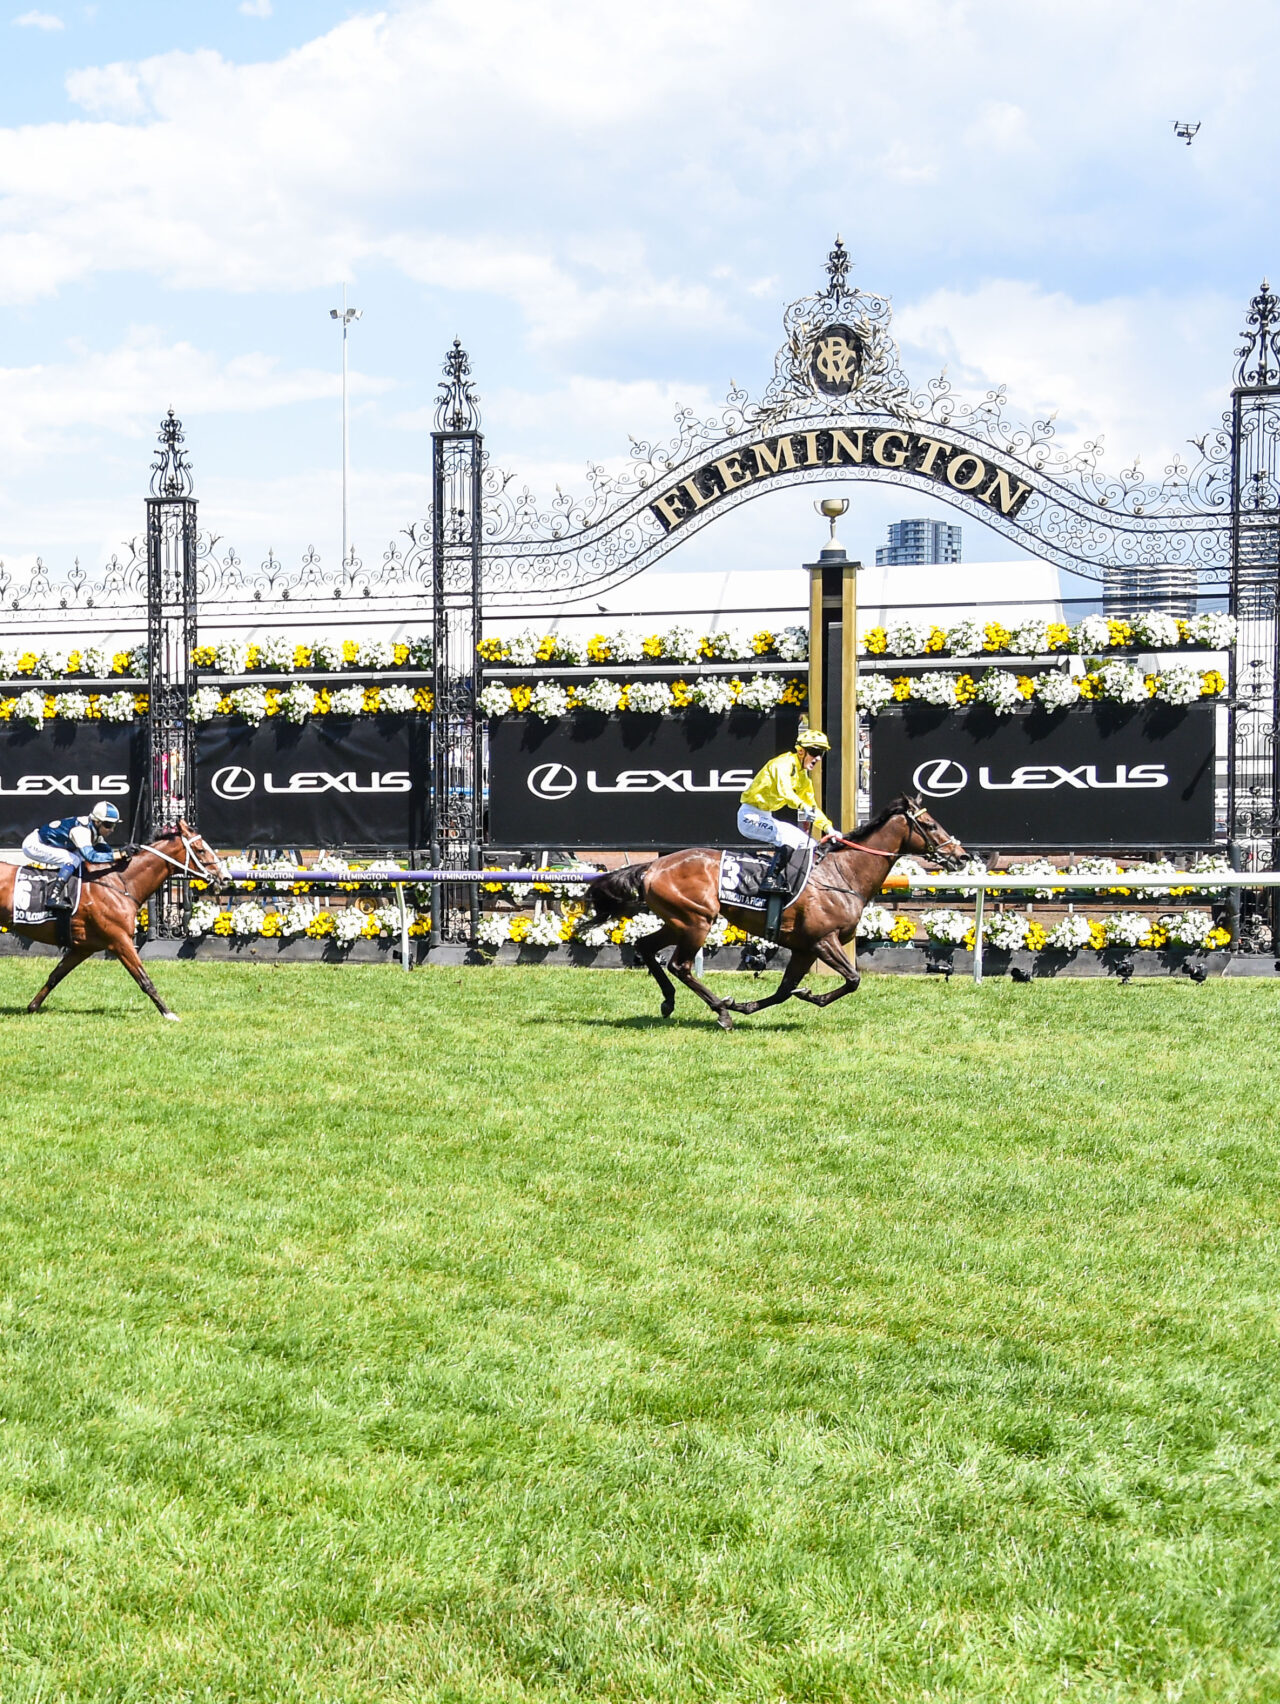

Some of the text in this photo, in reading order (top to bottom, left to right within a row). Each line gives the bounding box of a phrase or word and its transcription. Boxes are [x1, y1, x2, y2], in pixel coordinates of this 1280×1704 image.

[651, 429, 1032, 532] FLEMINGTON
[263, 771, 413, 794] LEXUS
[586, 769, 754, 793] LEXUS
[978, 764, 1169, 790] LEXUS
[246, 872, 294, 880] FLEMINGTON
[338, 873, 388, 881] FLEMINGTON
[433, 873, 484, 881] FLEMINGTON
[531, 874, 584, 882] FLEMINGTON
[721, 860, 741, 890] 3
[15, 880, 33, 910] 6
